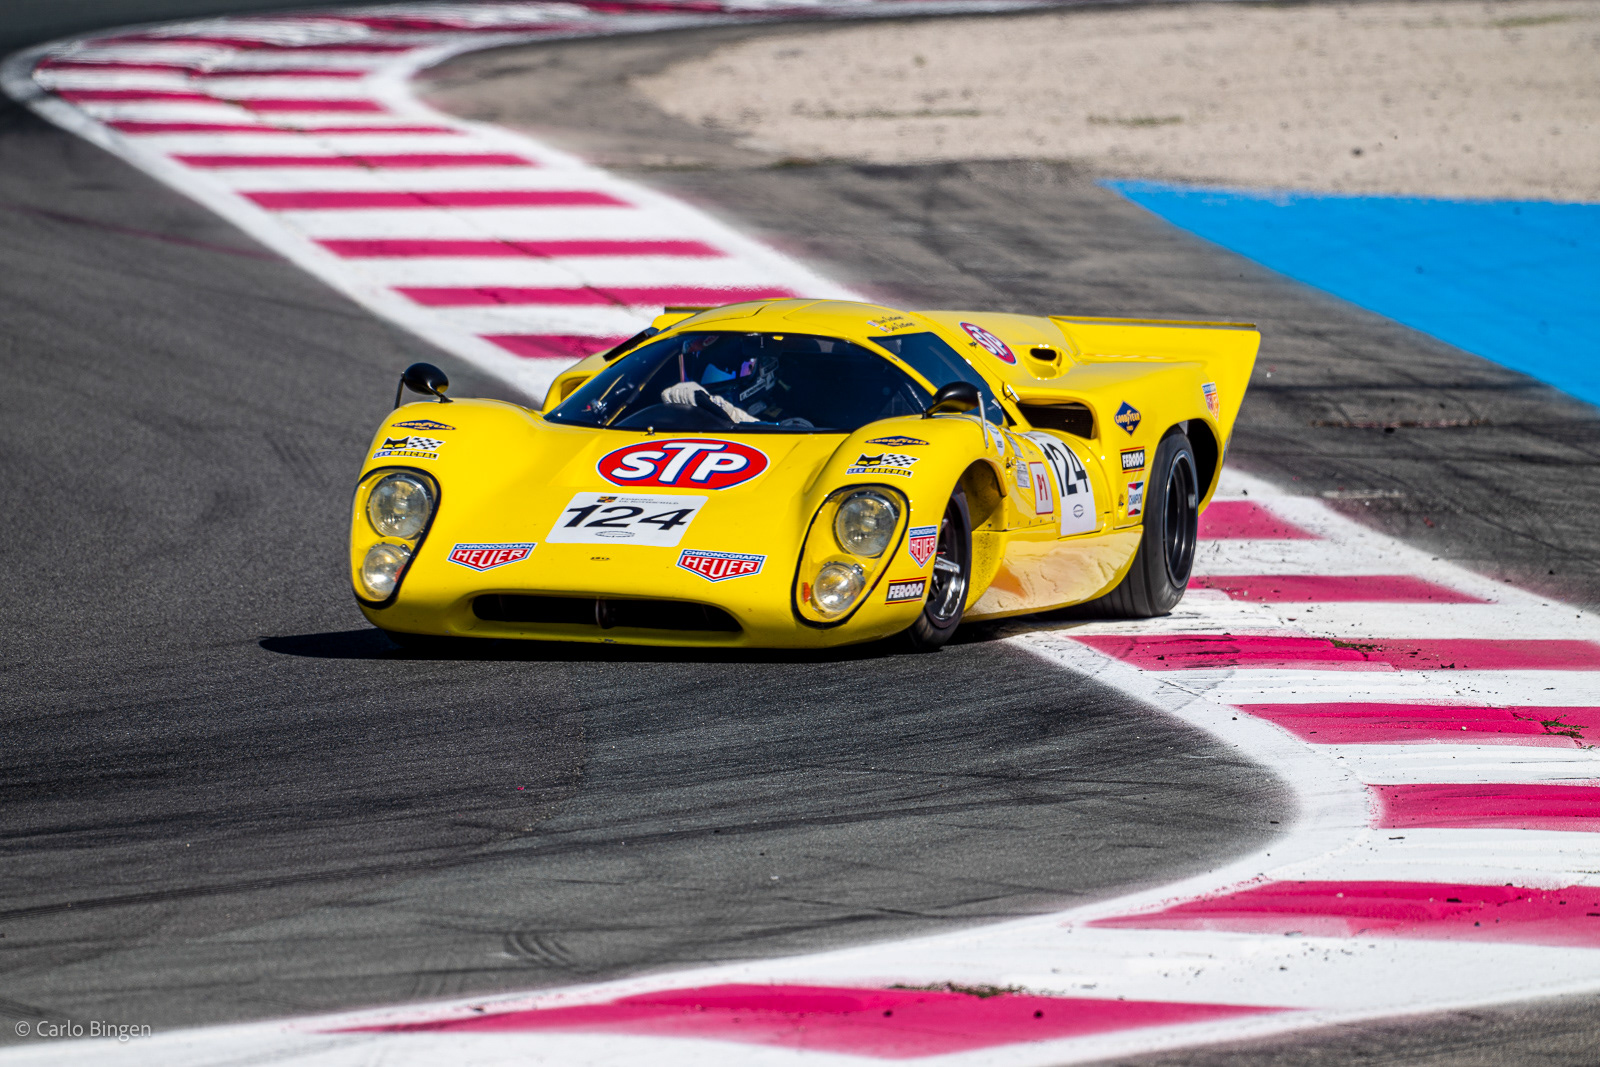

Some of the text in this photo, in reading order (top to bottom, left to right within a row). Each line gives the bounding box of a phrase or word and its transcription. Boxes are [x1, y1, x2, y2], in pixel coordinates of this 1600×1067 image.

[966, 325, 1010, 358] STP
[390, 451, 437, 459] MARCHAL
[611, 442, 750, 485] STP
[1122, 451, 1144, 468] FERODO
[864, 468, 911, 477] MARCHAL
[1040, 443, 1089, 497] 124
[563, 504, 696, 531] 124
[455, 550, 525, 567] HEUER
[684, 550, 764, 561] CHRONOGRAPH
[910, 537, 936, 562] HEUER
[685, 557, 755, 577] HEUER
[888, 583, 924, 599] FERODO
